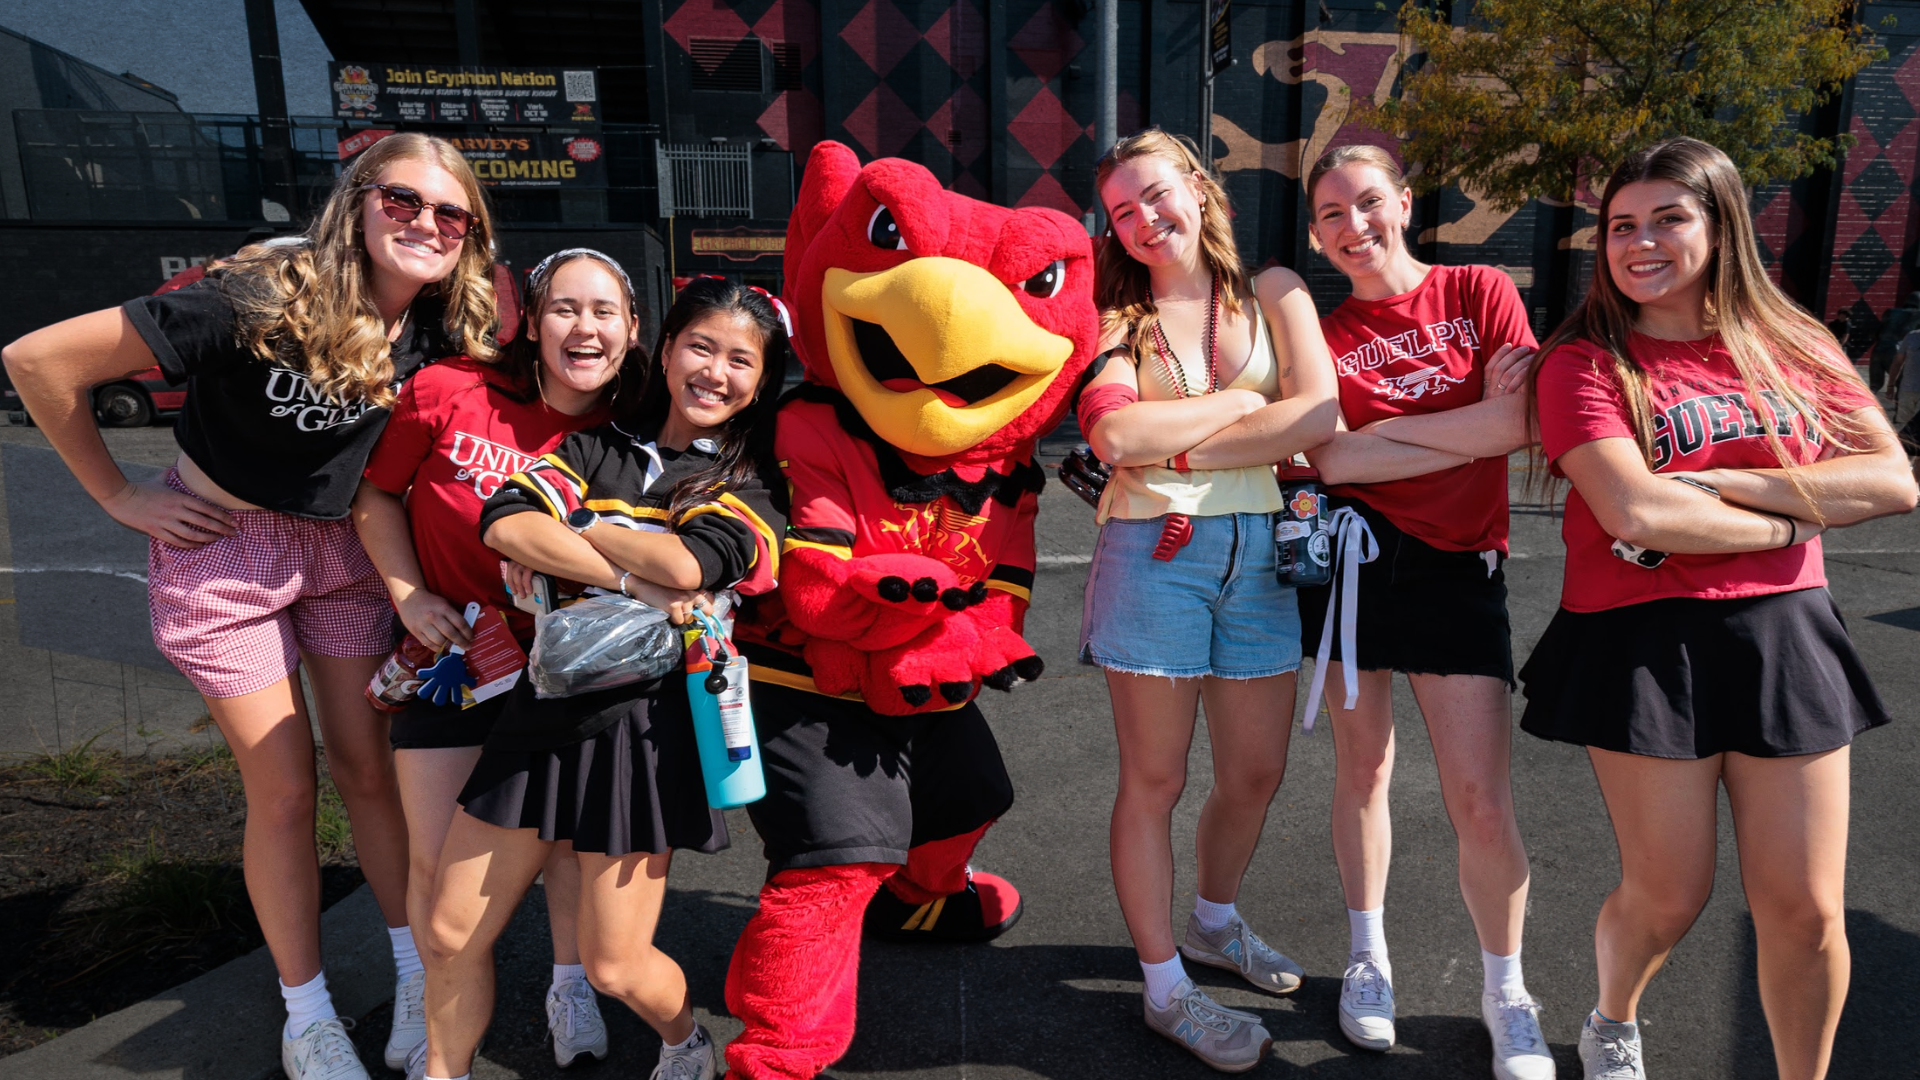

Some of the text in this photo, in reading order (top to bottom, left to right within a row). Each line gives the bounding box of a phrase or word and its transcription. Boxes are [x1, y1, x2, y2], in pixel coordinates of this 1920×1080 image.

[387, 69, 556, 87] Join Gryphon Nation
[420, 88, 434, 96] FUN
[462, 89, 471, 97] 90
[481, 103, 509, 111] Queen's
[344, 134, 371, 152] OCT 4
[470, 160, 576, 178] COMING
[701, 237, 751, 251] GRYPHON
[1336, 316, 1481, 378] GUELPH
[270, 403, 307, 418] of
[454, 467, 484, 482] of
